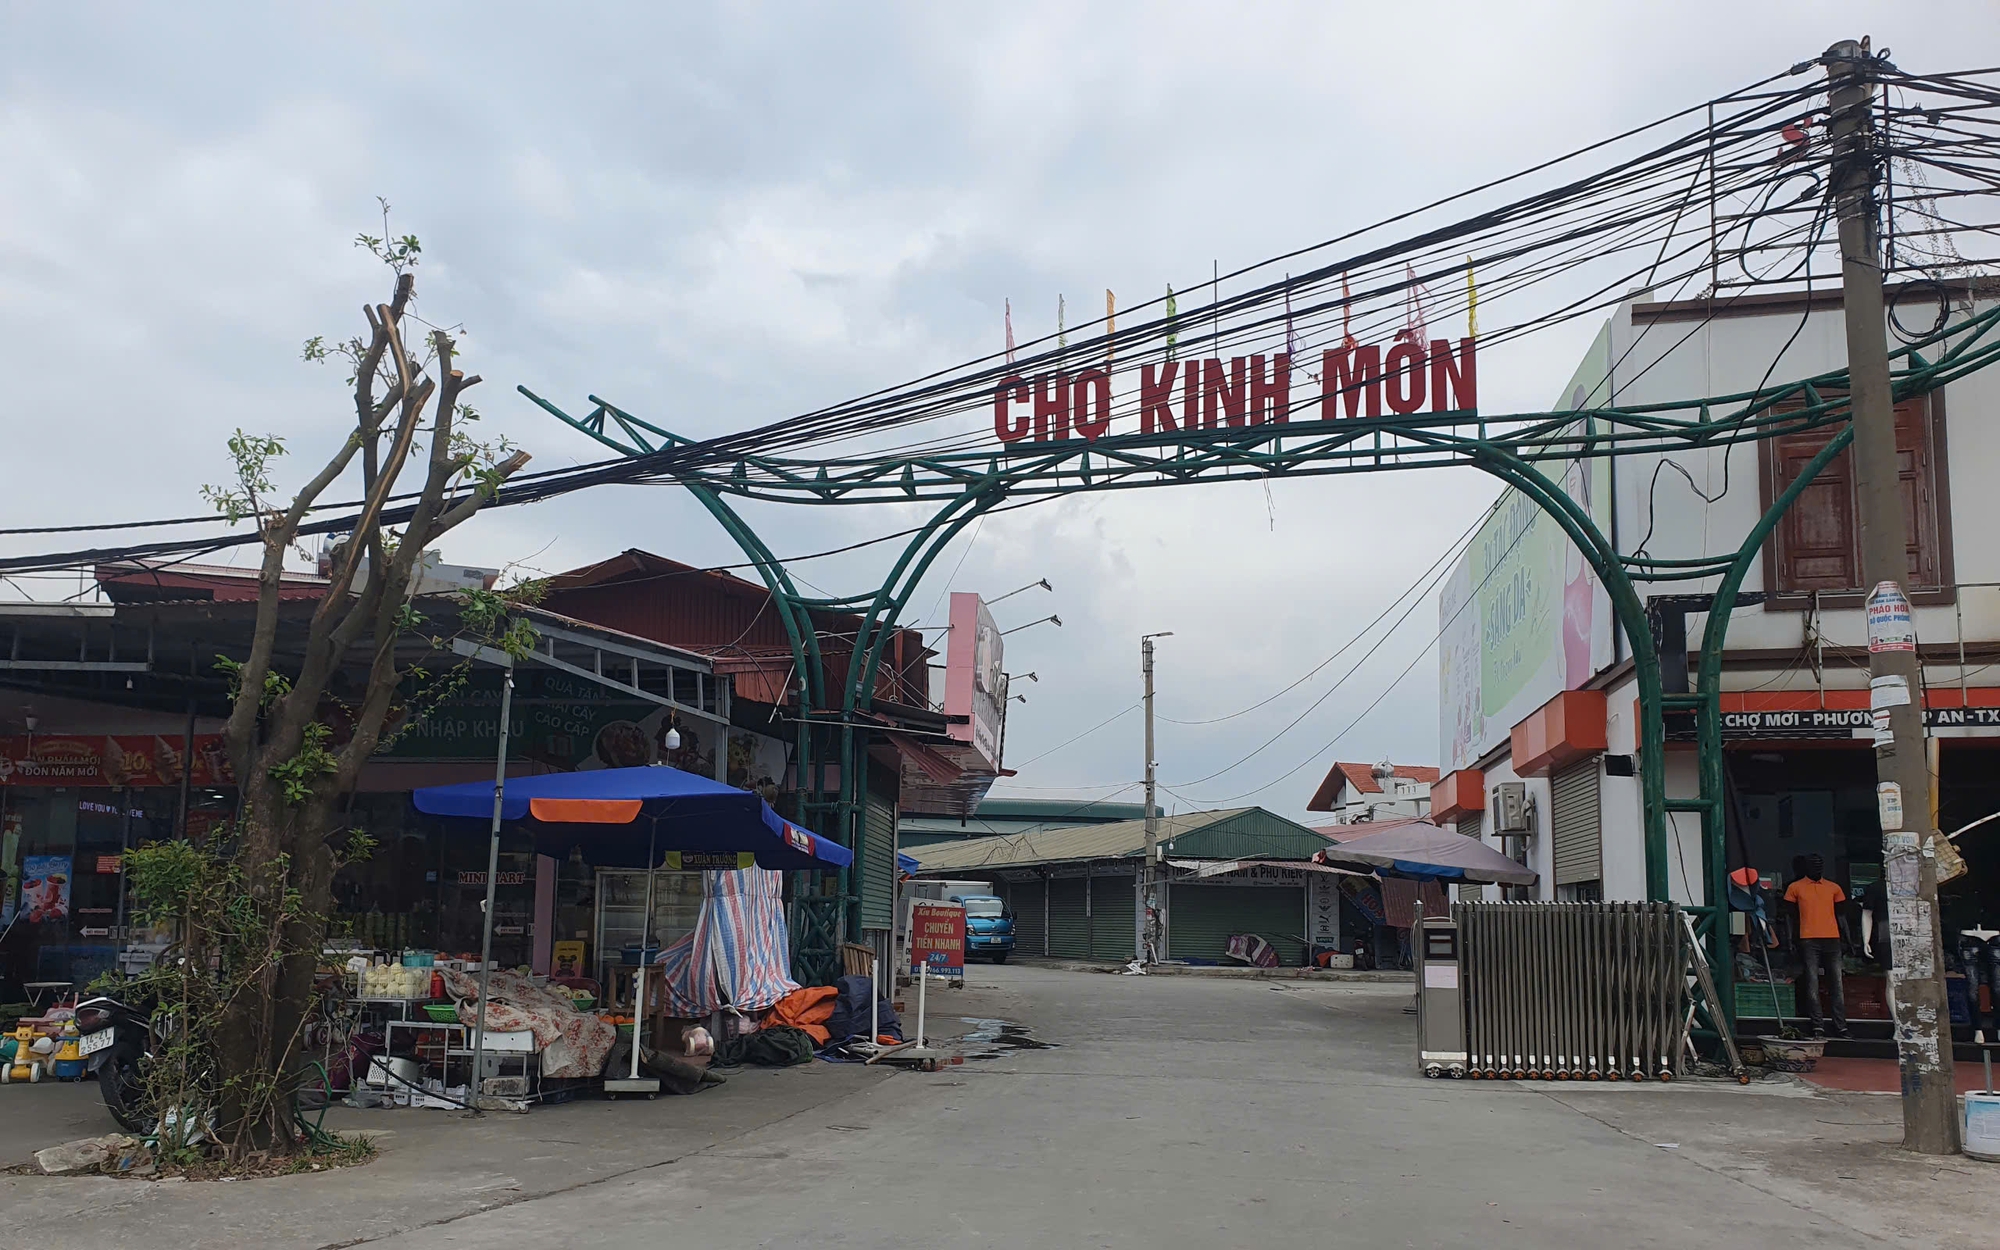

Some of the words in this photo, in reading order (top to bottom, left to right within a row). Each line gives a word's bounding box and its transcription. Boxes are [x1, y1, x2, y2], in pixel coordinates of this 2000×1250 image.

[1140, 353, 1290, 434] KINH
[1322, 329, 1477, 421] MÔN
[416, 716, 468, 742] NHẬP
[1725, 712, 1760, 730] CHỢ
[79, 801, 94, 811] LOVE
[934, 937, 961, 951] NHANH
[929, 953, 947, 962] 24/7
